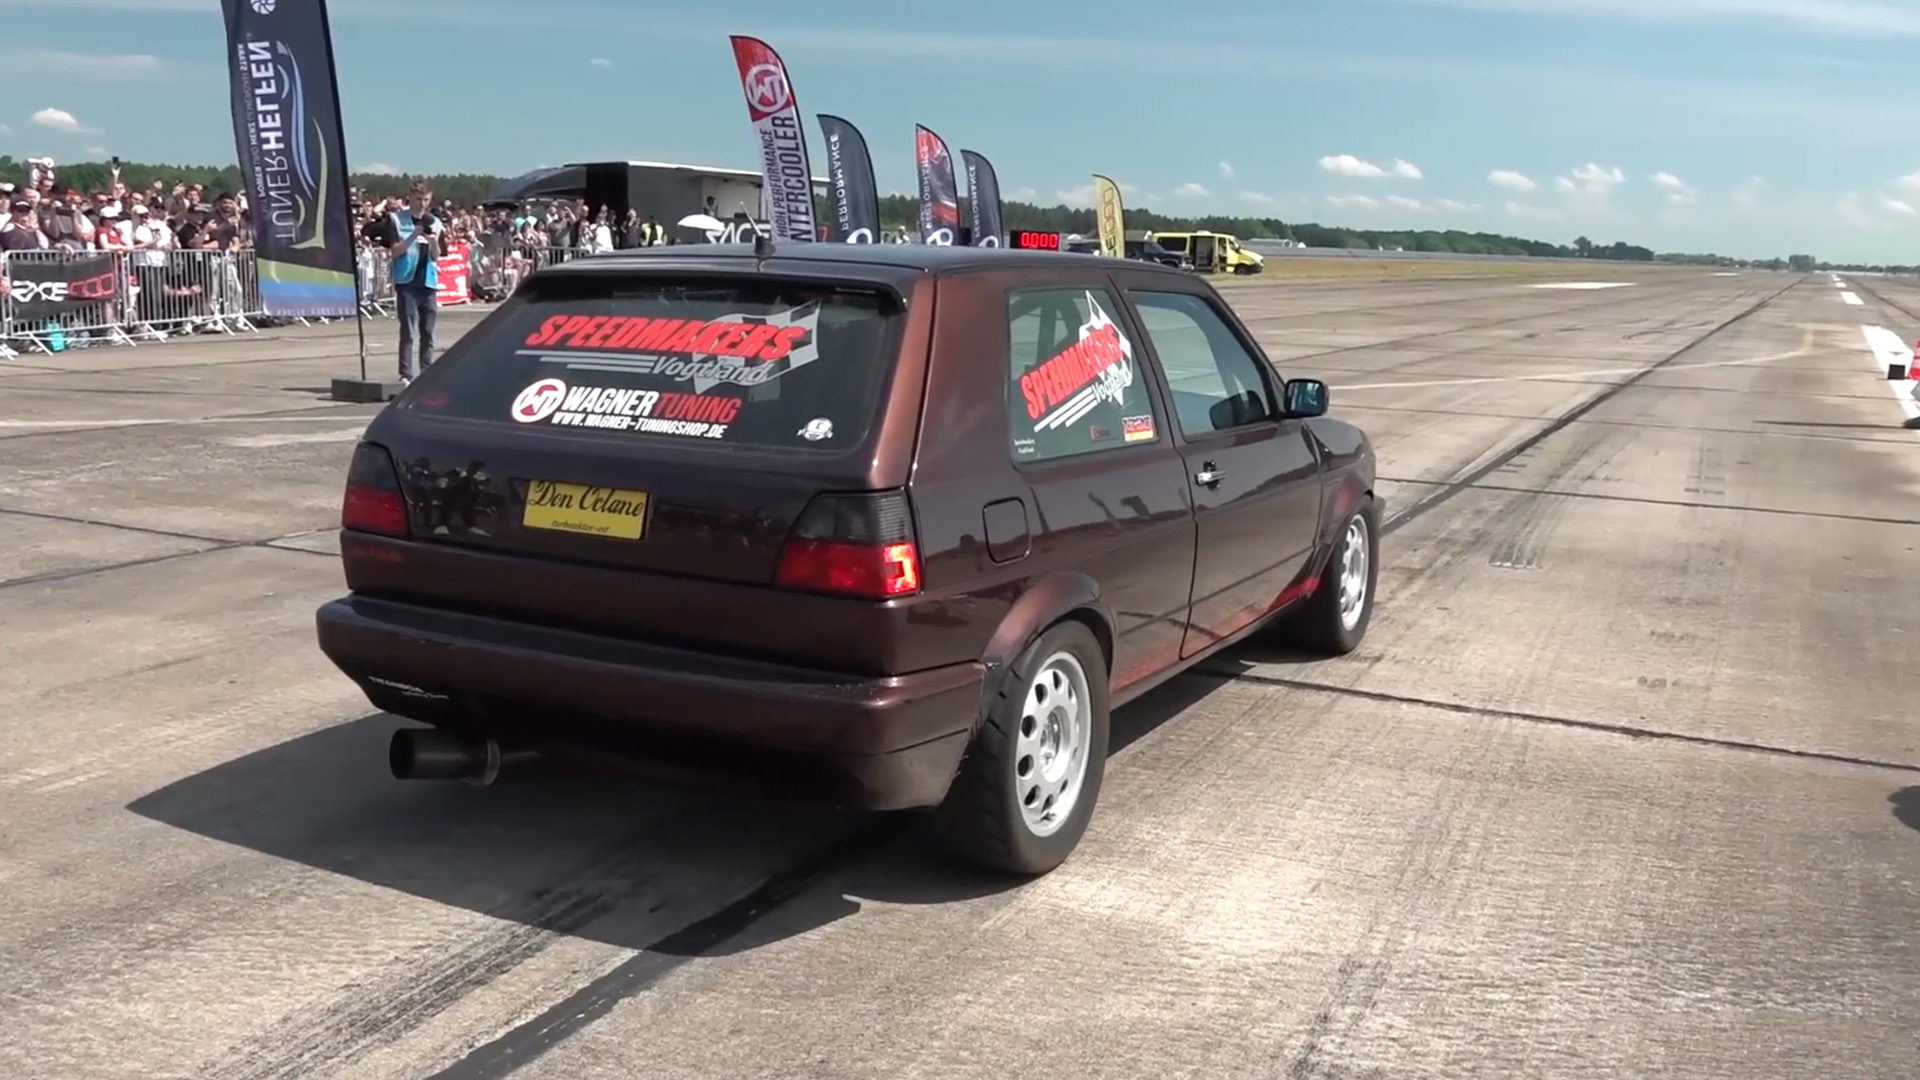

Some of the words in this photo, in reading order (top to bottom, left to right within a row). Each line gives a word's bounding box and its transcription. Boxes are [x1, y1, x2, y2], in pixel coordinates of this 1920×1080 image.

[760, 128, 784, 209] PERFORMANCE
[772, 115, 813, 242] NTERCOOLER
[772, 213, 789, 238] HIGH
[525, 315, 806, 360] SPEEDMAKERS
[651, 356, 774, 386] Vogtland
[1020, 322, 1124, 420] SPEEDMAKERS
[551, 411, 728, 439] WWW.WAGNER-TUNINGSHOP.DE
[528, 480, 574, 509] Don
